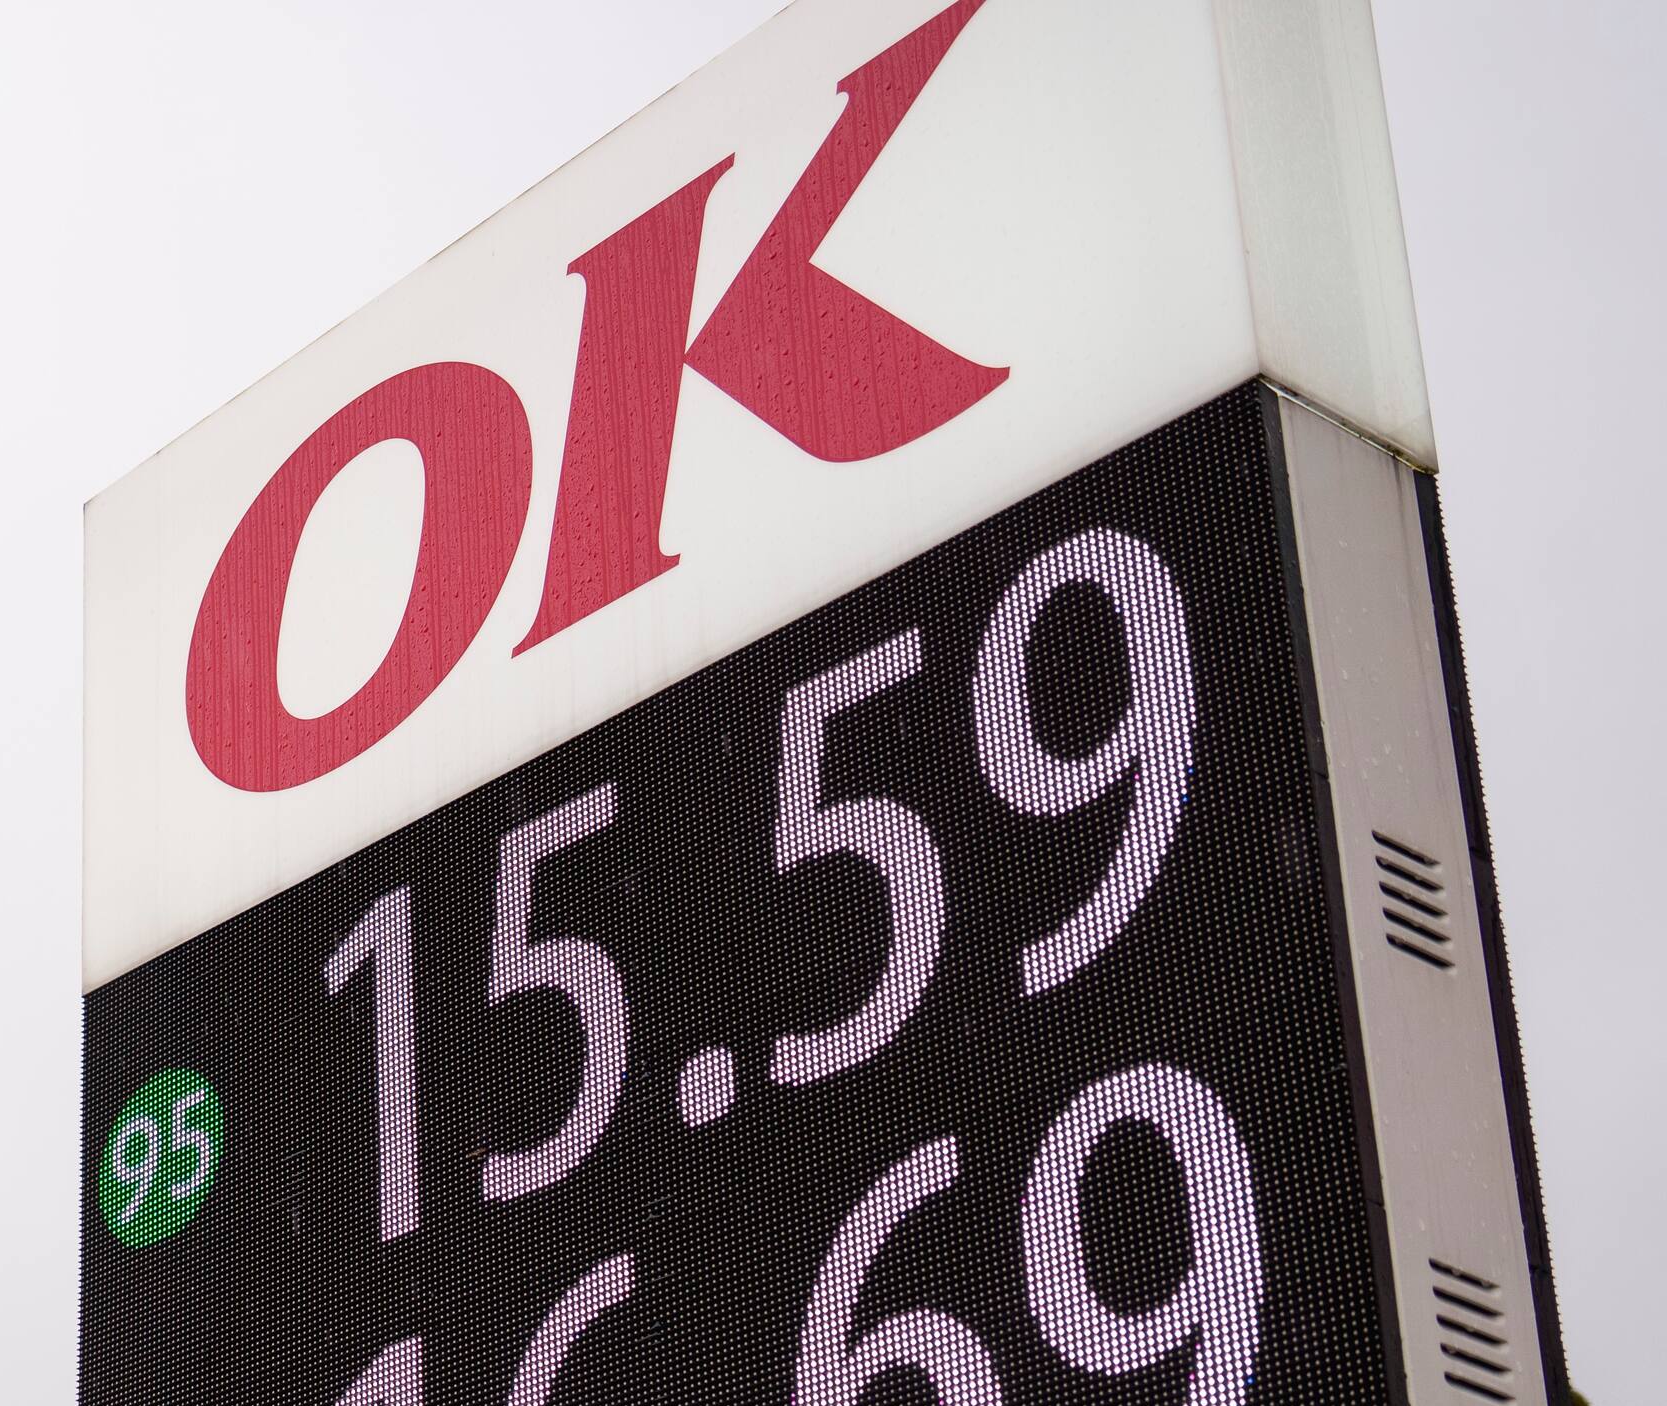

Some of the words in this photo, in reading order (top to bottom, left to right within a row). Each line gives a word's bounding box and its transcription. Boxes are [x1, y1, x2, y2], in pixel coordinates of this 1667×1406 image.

[185, 0, 1011, 793] OK
[113, 1087, 211, 1226] 95
[323, 526, 1197, 1242] 15.59
